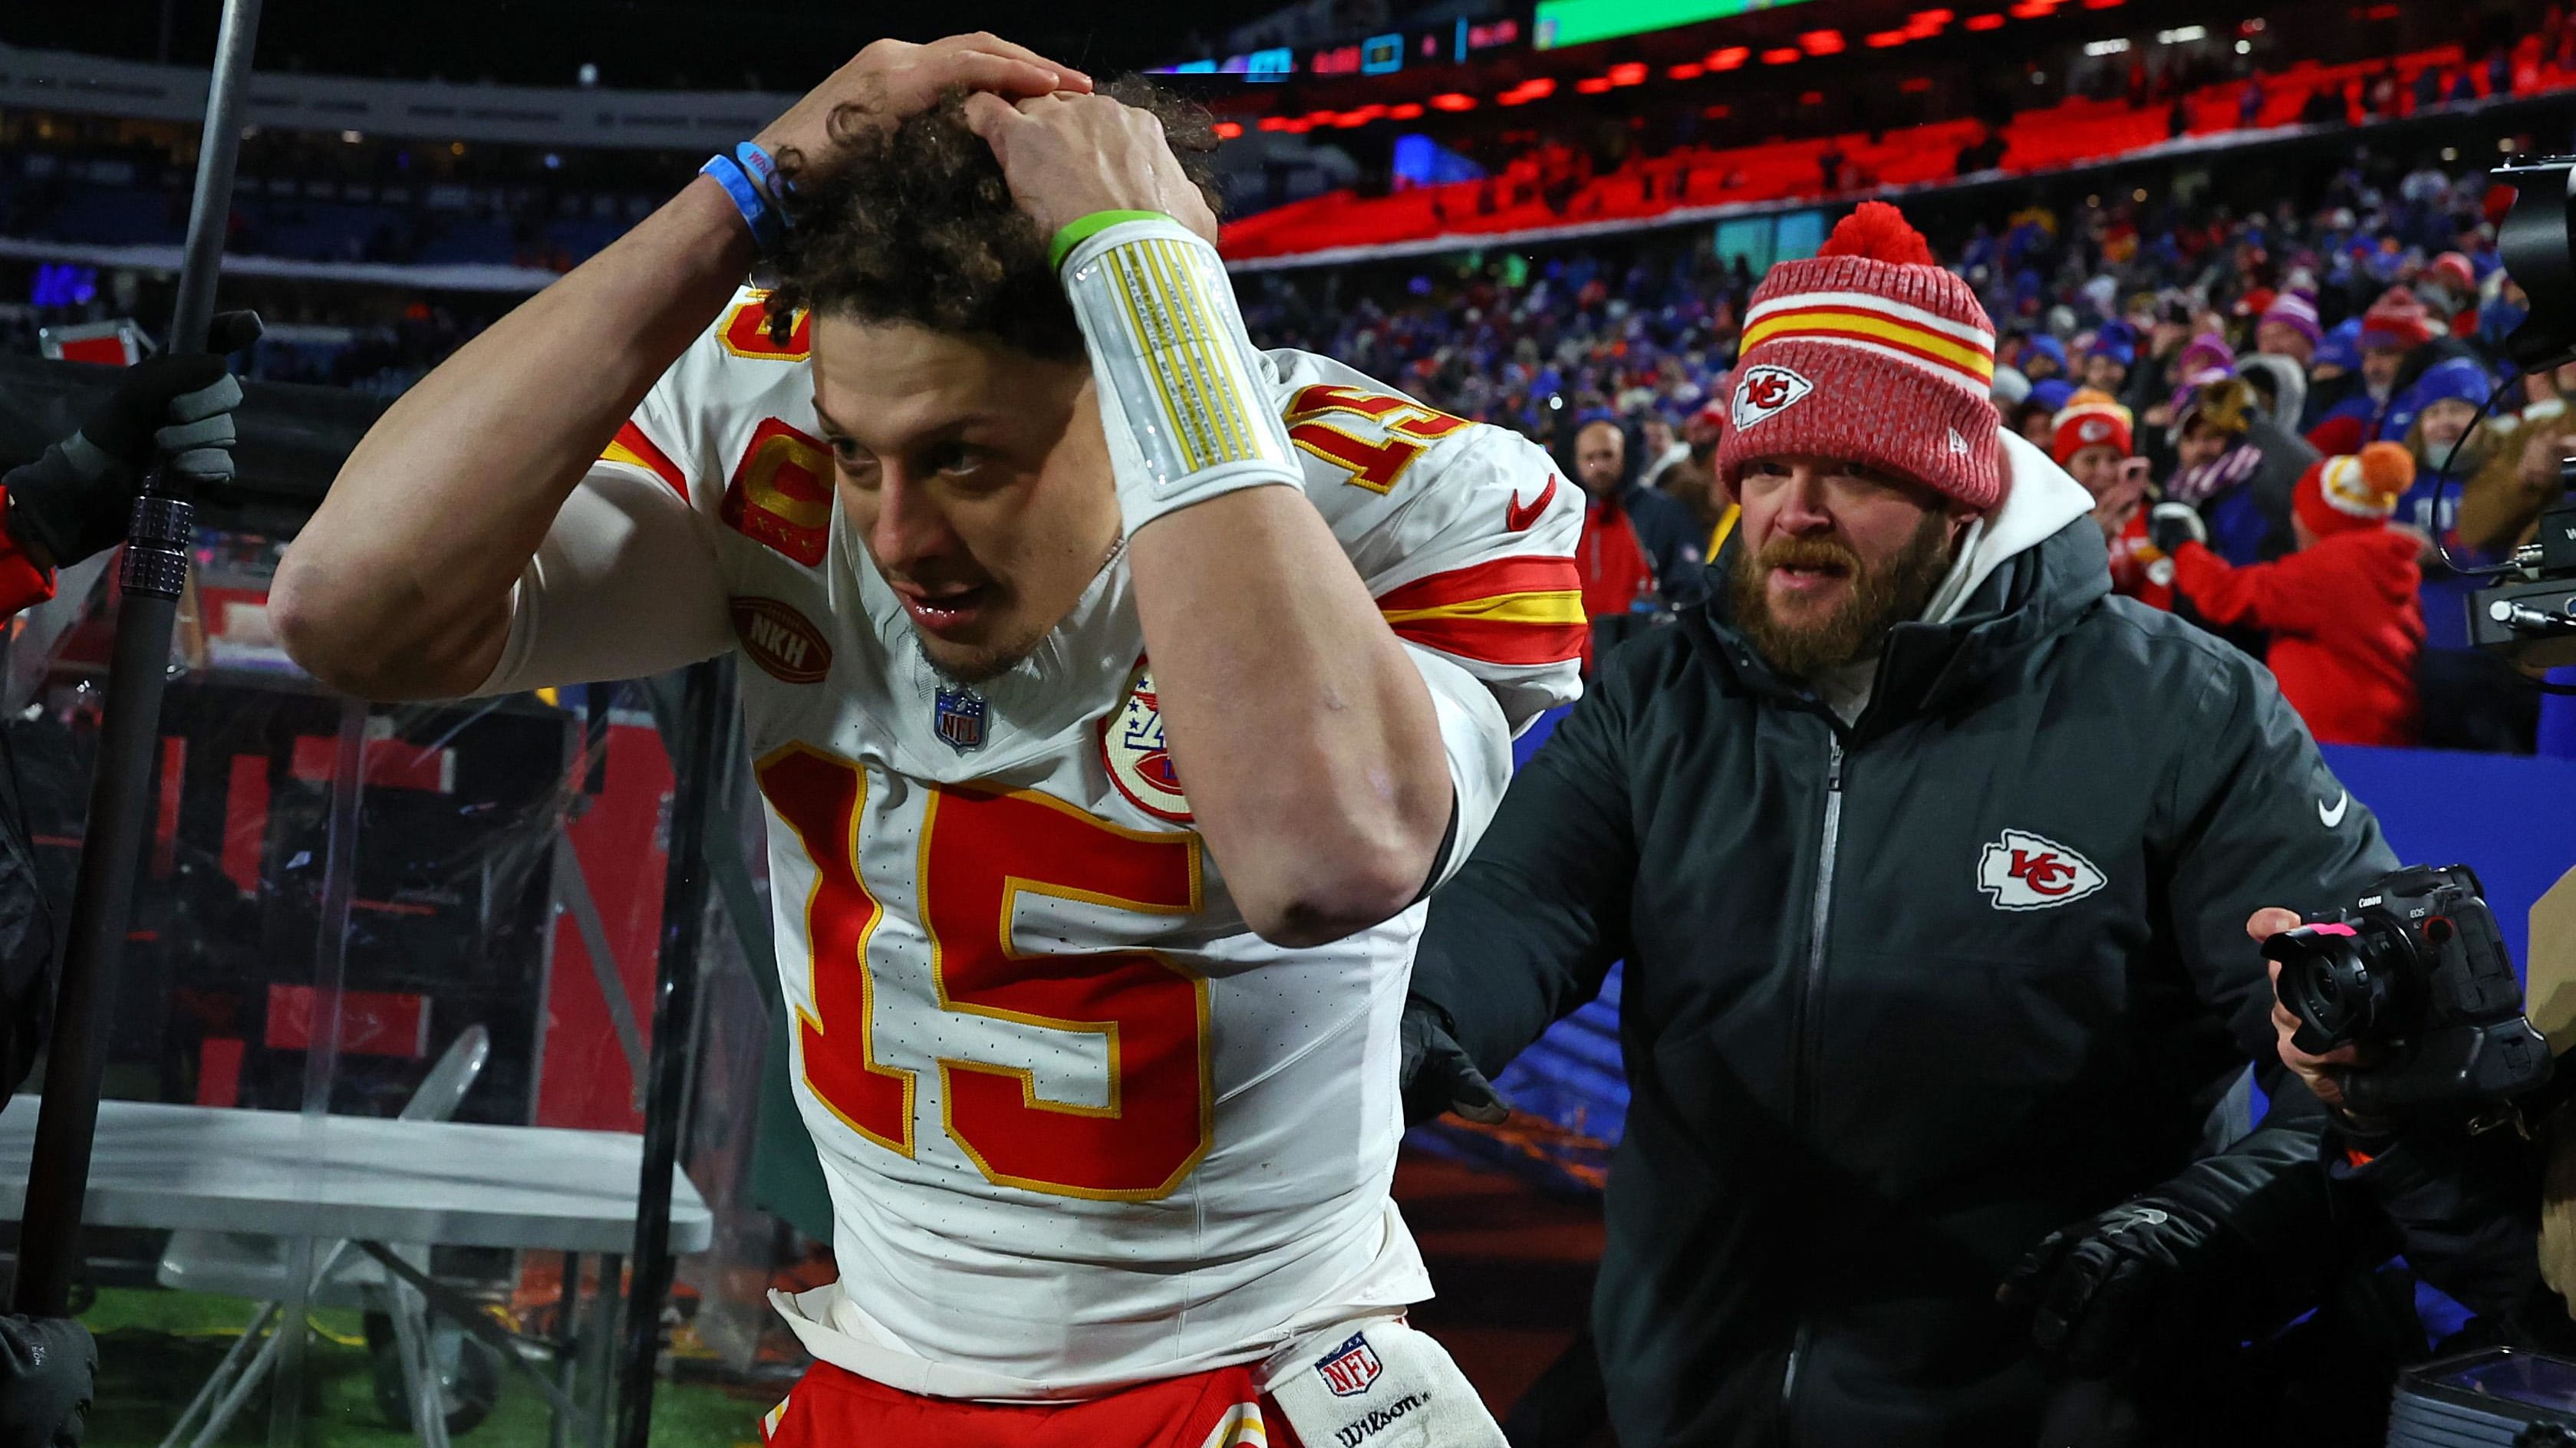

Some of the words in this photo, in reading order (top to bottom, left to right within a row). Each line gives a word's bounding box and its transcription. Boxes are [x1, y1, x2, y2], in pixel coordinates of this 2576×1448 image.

[1746, 374, 1790, 409] KC
[1283, 383, 1481, 495] 15
[749, 611, 810, 669] NKH
[940, 712, 980, 744] NFL
[2008, 849, 2077, 896] KC
[2358, 896, 2382, 908] Canon
[2410, 907, 2425, 919] EOS
[752, 739, 1214, 1201] 15
[1323, 1349, 1380, 1392] NFL
[1335, 1395, 1421, 1448] Wilson
